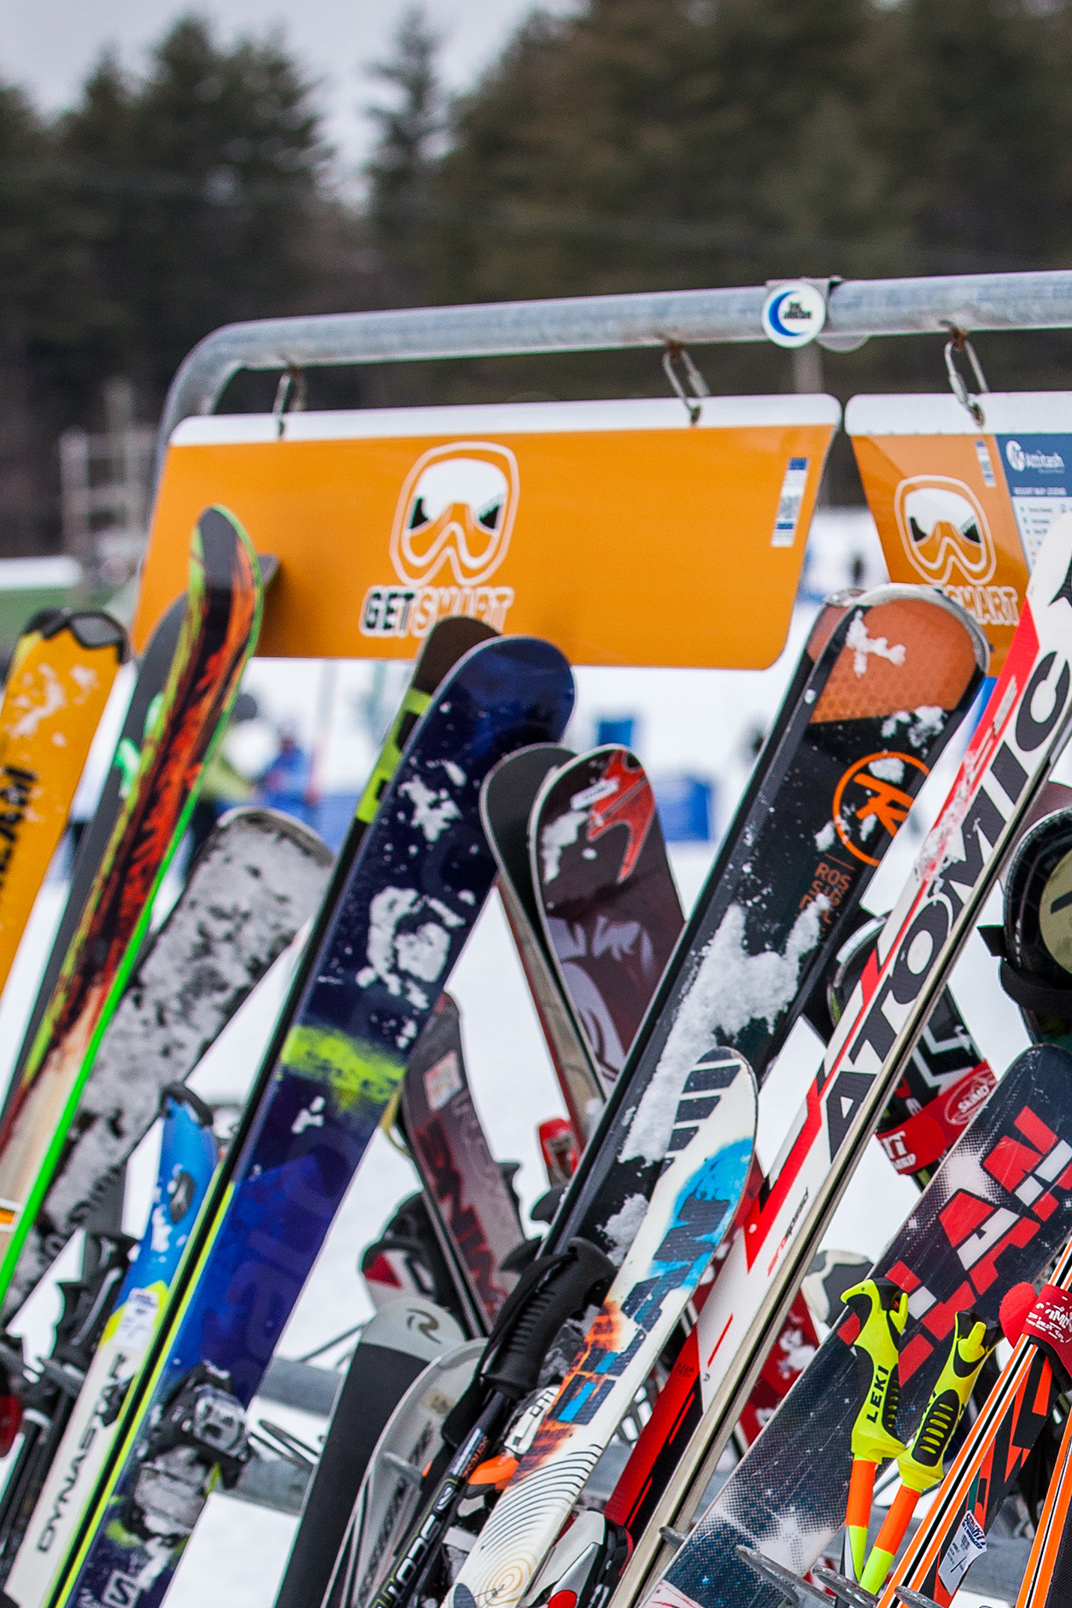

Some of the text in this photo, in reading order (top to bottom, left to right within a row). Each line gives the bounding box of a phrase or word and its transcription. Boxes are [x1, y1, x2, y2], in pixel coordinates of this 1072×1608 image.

[826, 651, 1071, 1164] ATOMIC
[36, 1353, 128, 1554] DYNASTAR
[866, 1366, 889, 1424] LEKI
